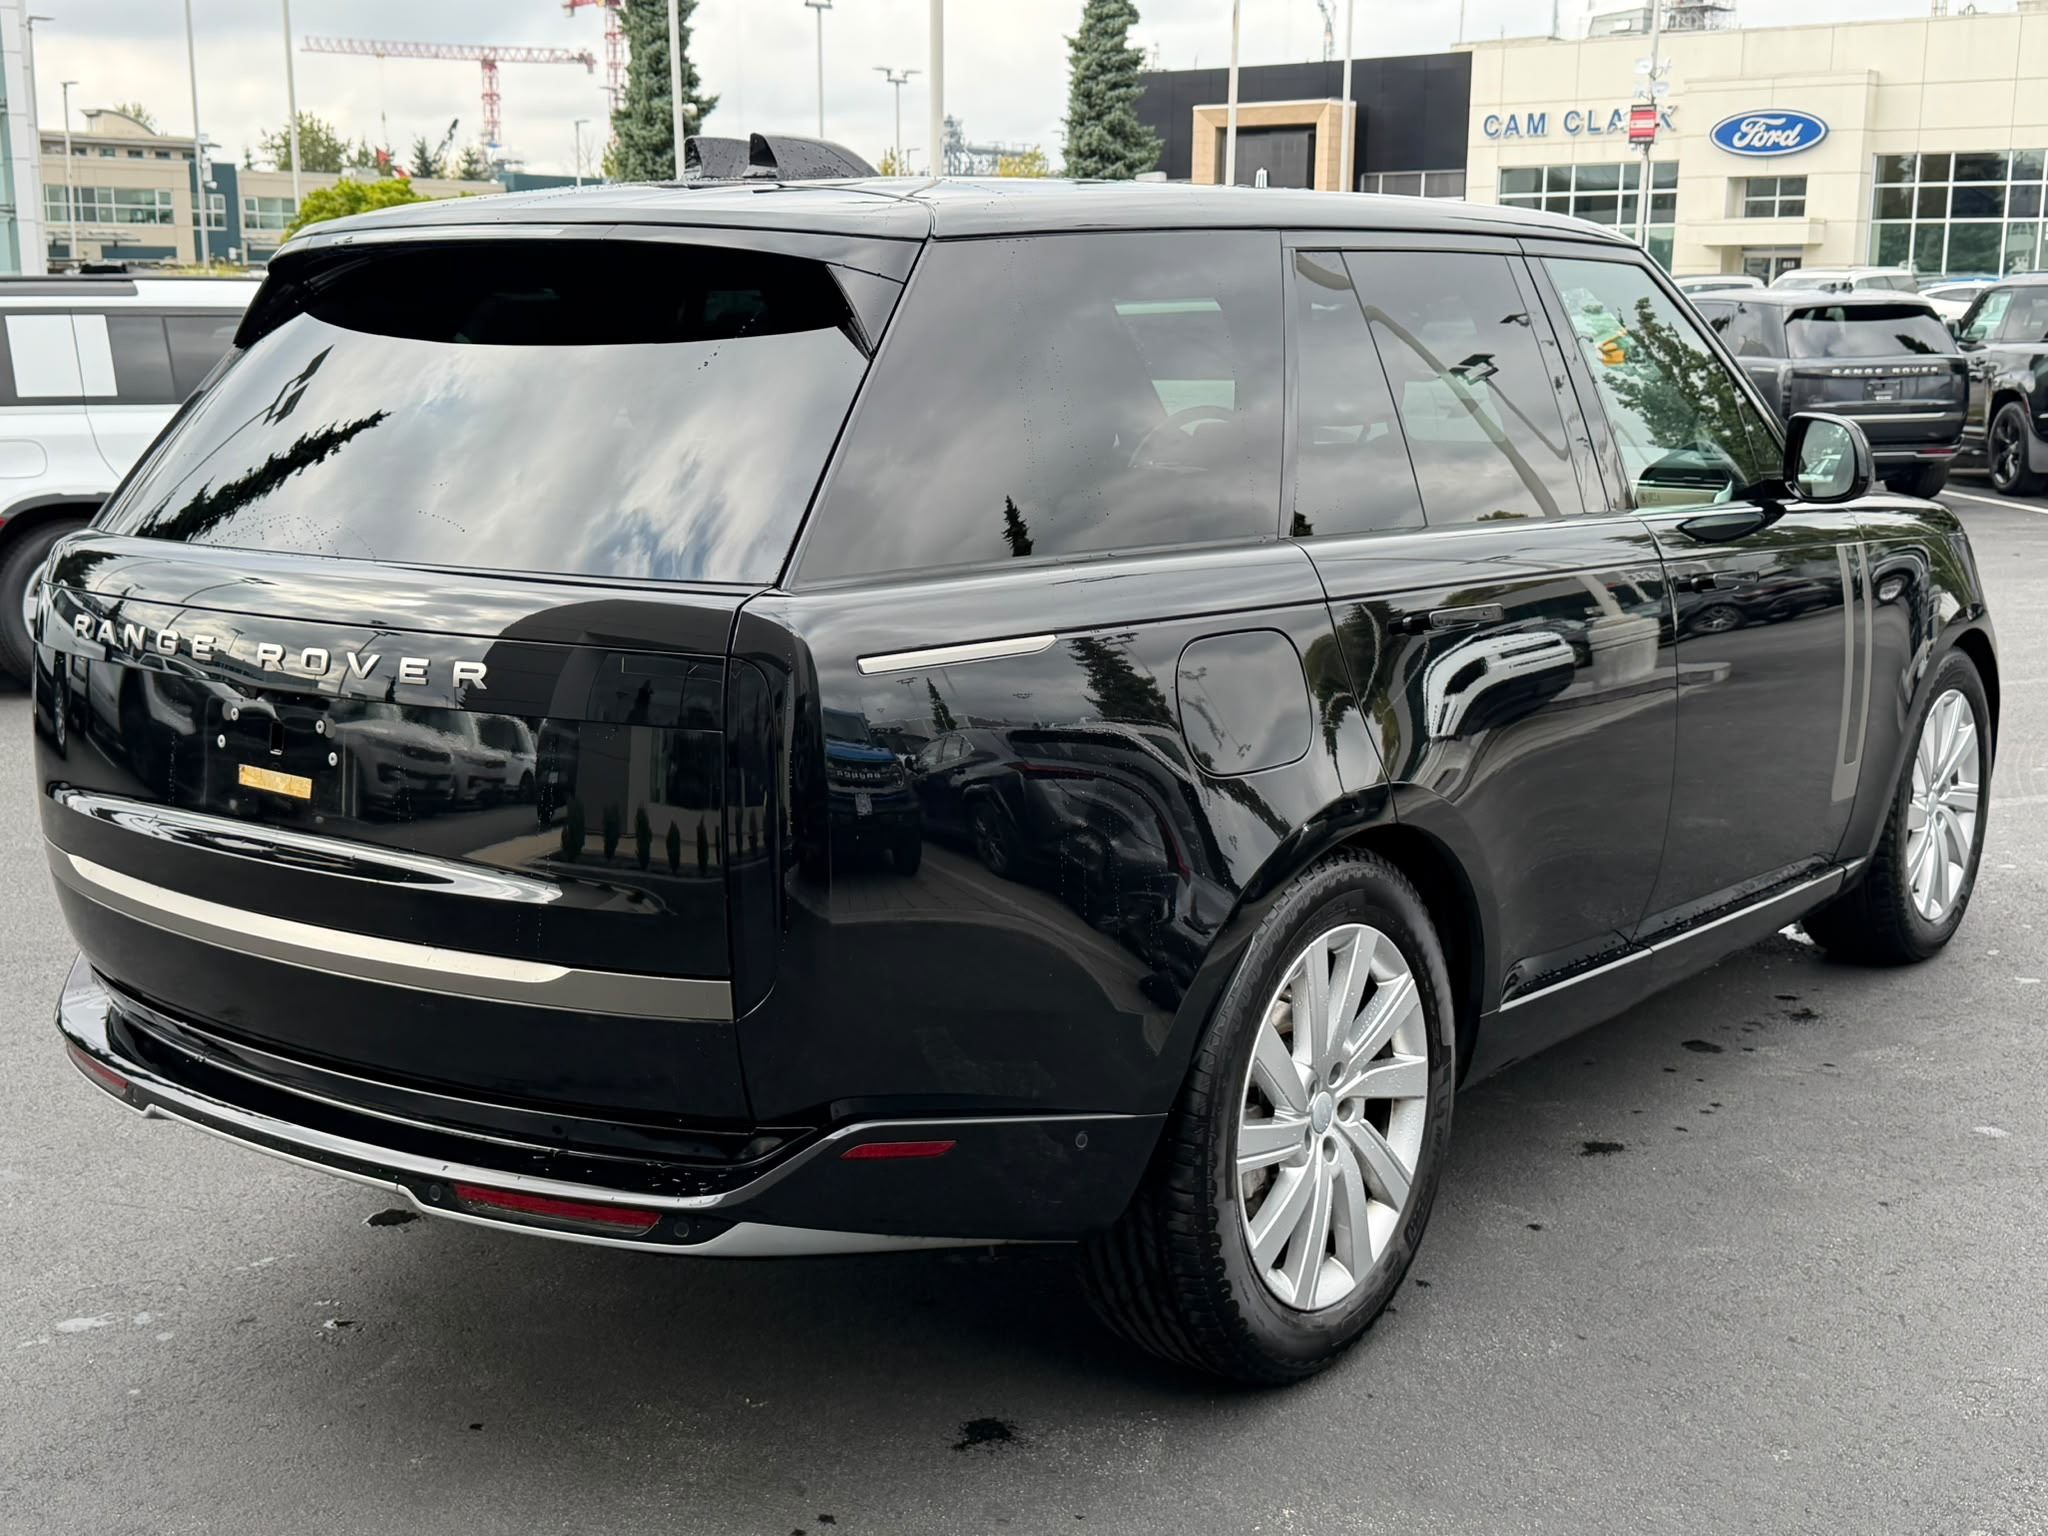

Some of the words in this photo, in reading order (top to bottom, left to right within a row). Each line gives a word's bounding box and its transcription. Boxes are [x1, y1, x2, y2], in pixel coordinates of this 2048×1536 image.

[1484, 113, 1547, 137] CAM
[1563, 105, 1678, 136] CLAK
[1731, 115, 1804, 149] Ford
[73, 613, 217, 661] RANGE
[256, 643, 488, 690] ROVER
